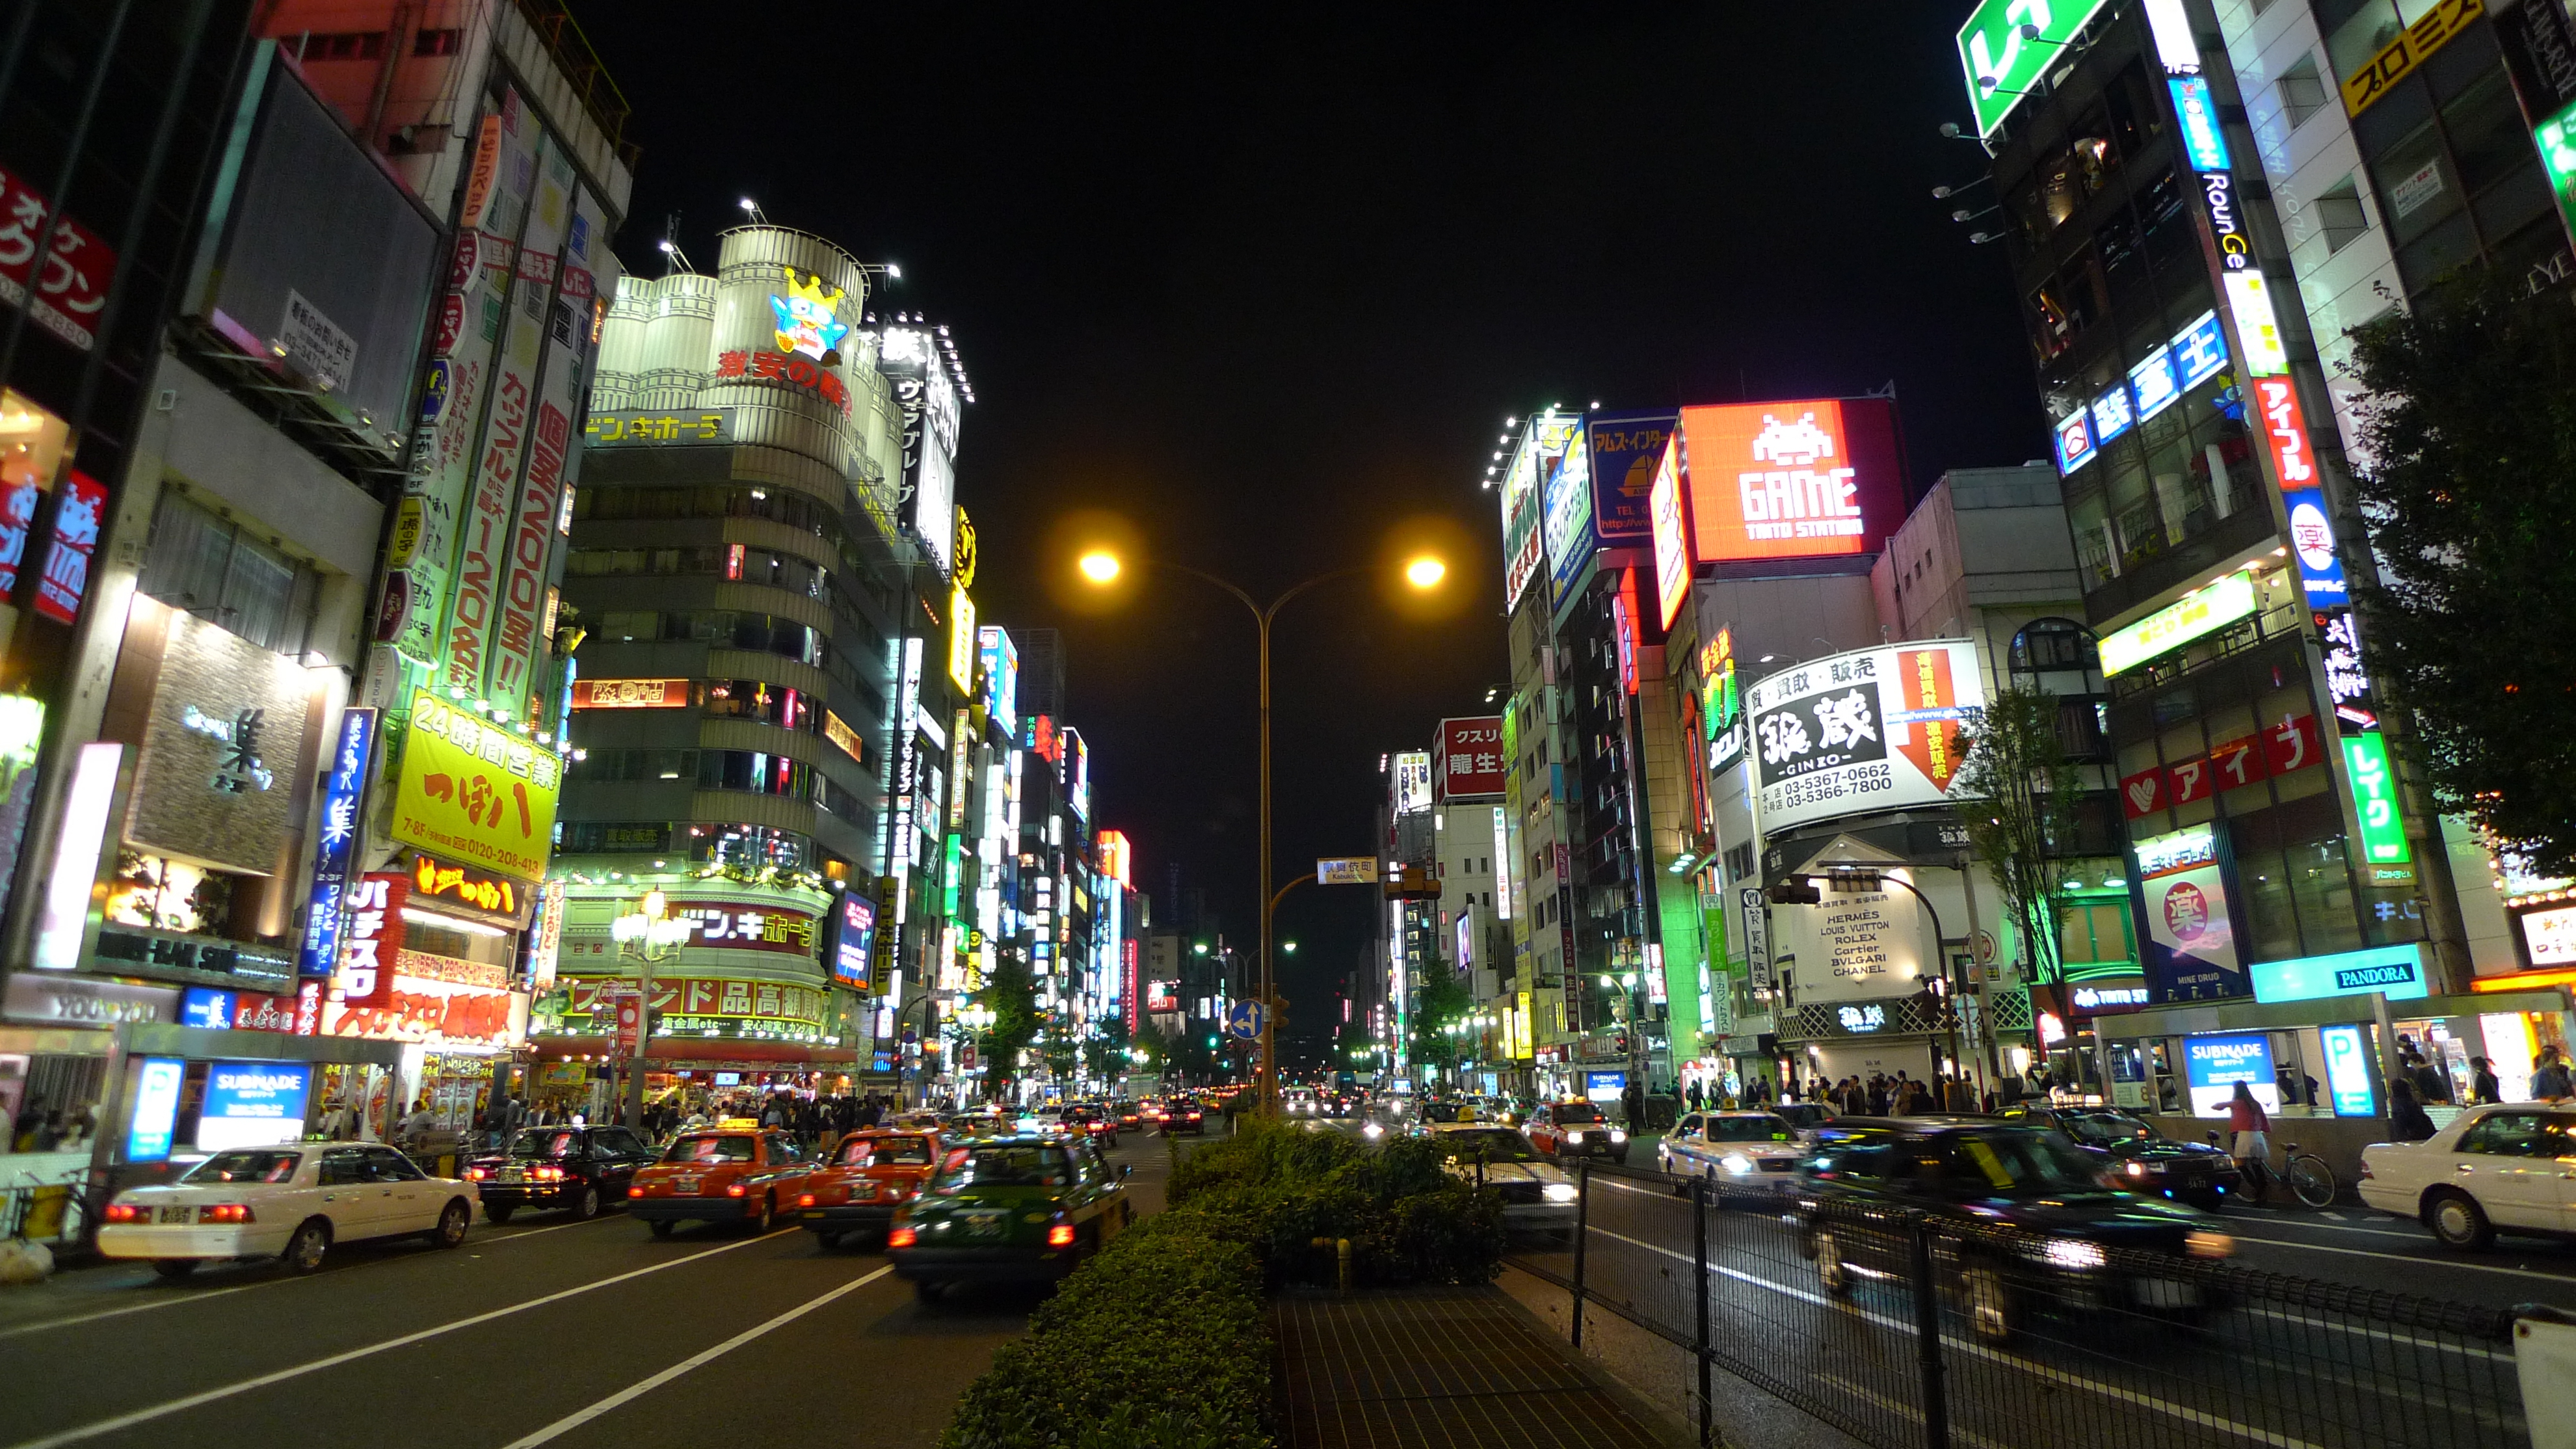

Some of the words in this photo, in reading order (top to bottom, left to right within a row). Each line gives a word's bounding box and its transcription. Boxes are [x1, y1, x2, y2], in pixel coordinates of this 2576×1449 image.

[2261, 382, 2311, 481] アイフル
[1738, 468, 1861, 521] GAME
[1746, 522, 1792, 540] TAITO
[2294, 524, 2330, 553] 薬
[414, 696, 561, 791] 24時間営業
[1450, 752, 1505, 776] 龍生
[1785, 764, 1891, 796] 03-5367-0662
[1786, 777, 1892, 808] 03-5366-7800
[2352, 744, 2391, 828] レイク
[423, 773, 532, 840] つぼ八
[468, 839, 539, 874] 0120-208-413
[1323, 860, 1372, 872] 歌舞伎町
[2166, 890, 2206, 934] 薬
[347, 880, 390, 999] パチスロ
[1820, 924, 1846, 936] LOUIS
[1850, 920, 1890, 933] VUITTON
[1835, 933, 1877, 944] ROLEX
[1831, 953, 1887, 966] BVLGARI
[1835, 944, 1879, 956] Cartier
[1833, 964, 1887, 977] CHANEL
[2177, 974, 2197, 985] MINE
[2198, 971, 2220, 983] DRUG
[2340, 966, 2411, 987] PANDORA
[2191, 1043, 2263, 1060] SUBNADE
[2330, 1035, 2351, 1067] P
[217, 1072, 302, 1092] SUBNADE
